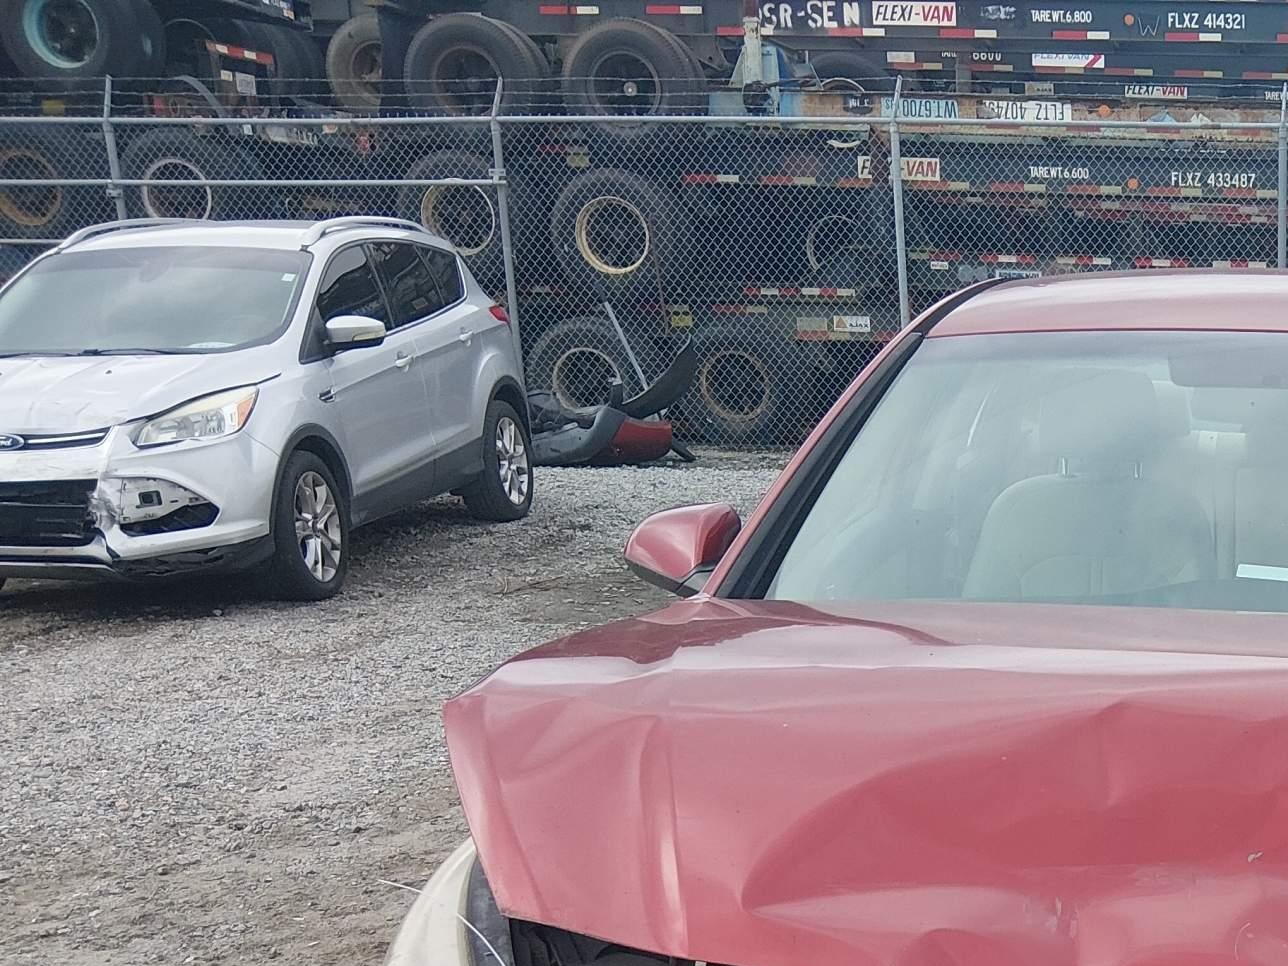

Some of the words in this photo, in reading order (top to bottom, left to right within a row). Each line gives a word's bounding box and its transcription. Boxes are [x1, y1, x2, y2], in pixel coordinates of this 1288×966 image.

[875, 5, 954, 24] FLEXI-VAN
[1168, 13, 1199, 28] FLXZ
[1203, 14, 1246, 29] 414321
[1126, 85, 1186, 96] FLEXI-VAN
[1035, 103, 1065, 120] FLTZ
[1171, 172, 1200, 186] FLXZ
[1207, 173, 1256, 188] 433487
